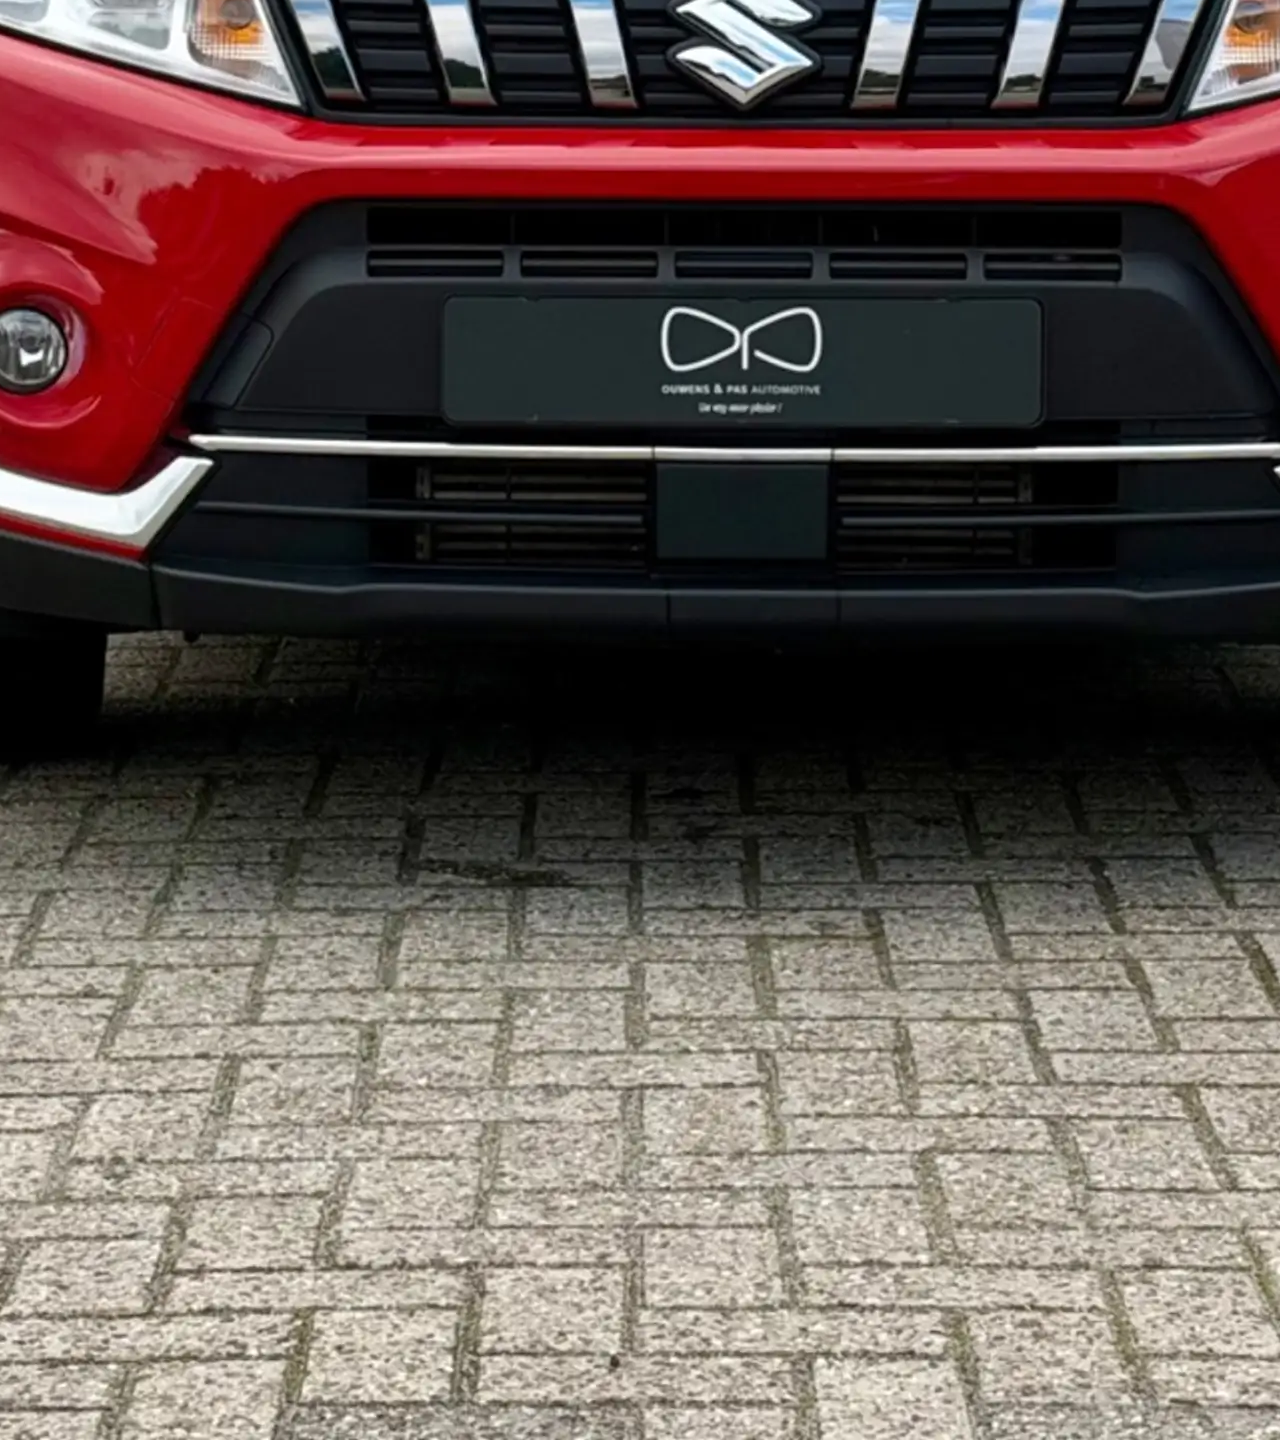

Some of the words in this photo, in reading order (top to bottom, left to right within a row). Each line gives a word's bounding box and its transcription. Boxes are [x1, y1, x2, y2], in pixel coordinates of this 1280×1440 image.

[661, 384, 710, 394] OUWENS
[713, 383, 723, 394] &
[727, 384, 748, 394] PAS
[751, 384, 821, 395] AUTOMOTIVE
